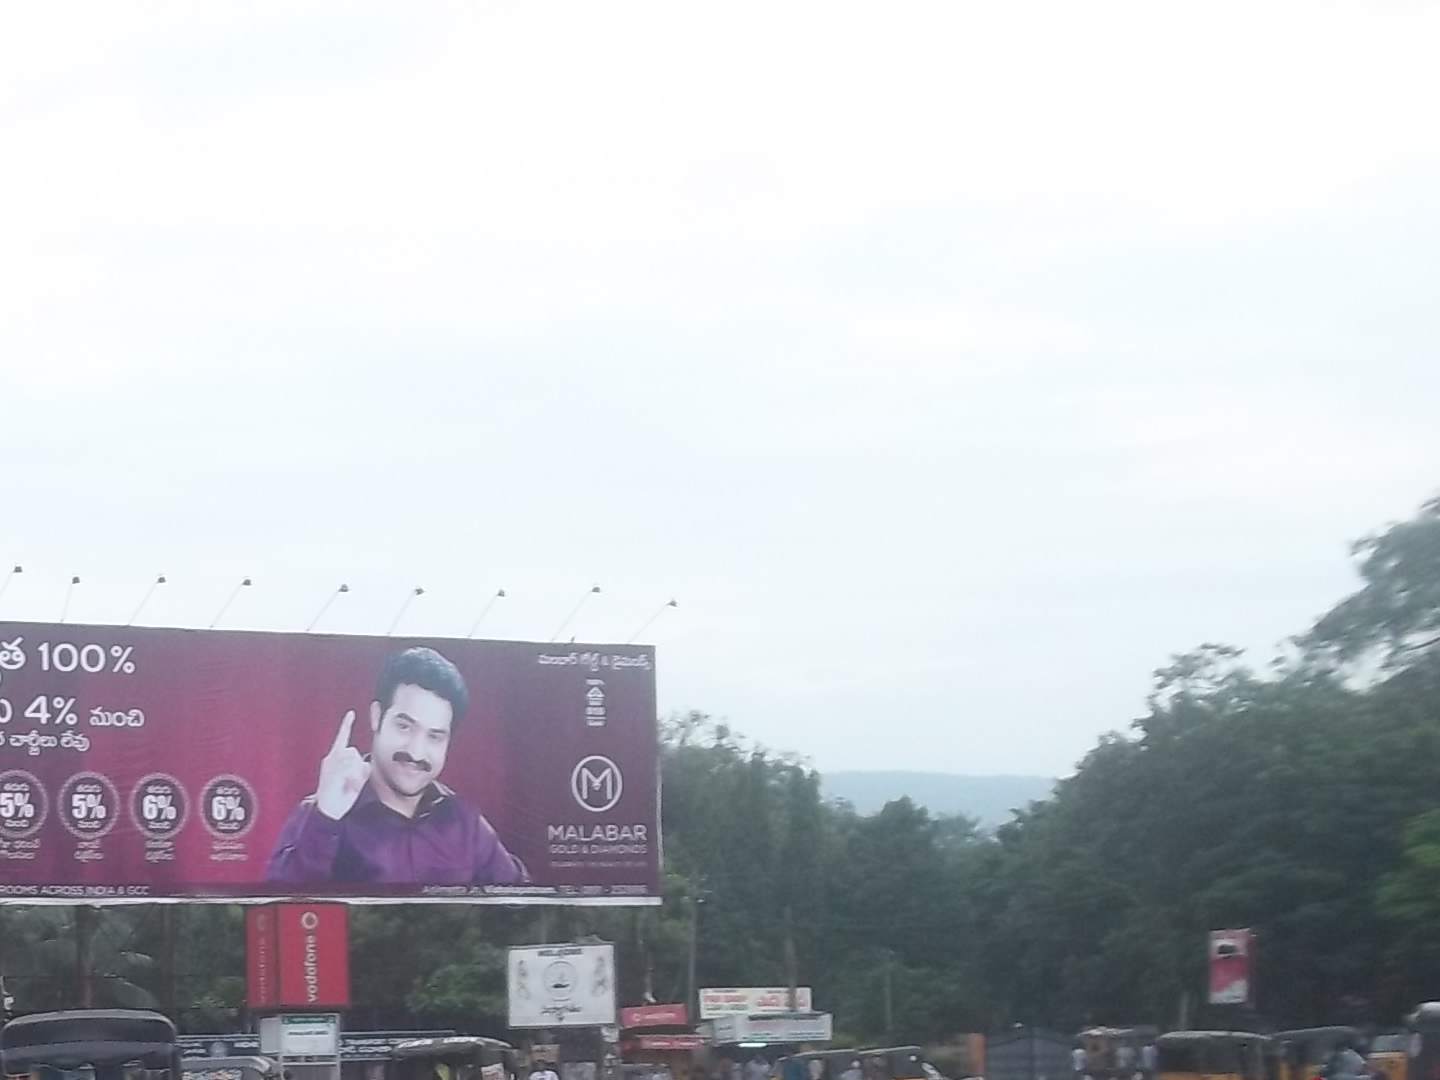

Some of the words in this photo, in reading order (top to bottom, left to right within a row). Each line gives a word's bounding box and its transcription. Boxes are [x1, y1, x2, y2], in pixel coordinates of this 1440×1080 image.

[37, 642, 137, 675] 100%
[24, 695, 79, 726] 4%
[71, 794, 107, 819] 5%
[142, 795, 177, 820] 6%
[211, 795, 246, 821] 6%
[547, 824, 648, 842] MALABAR
[40, 885, 84, 896] ACROSS
[303, 935, 318, 1003] vodafone
